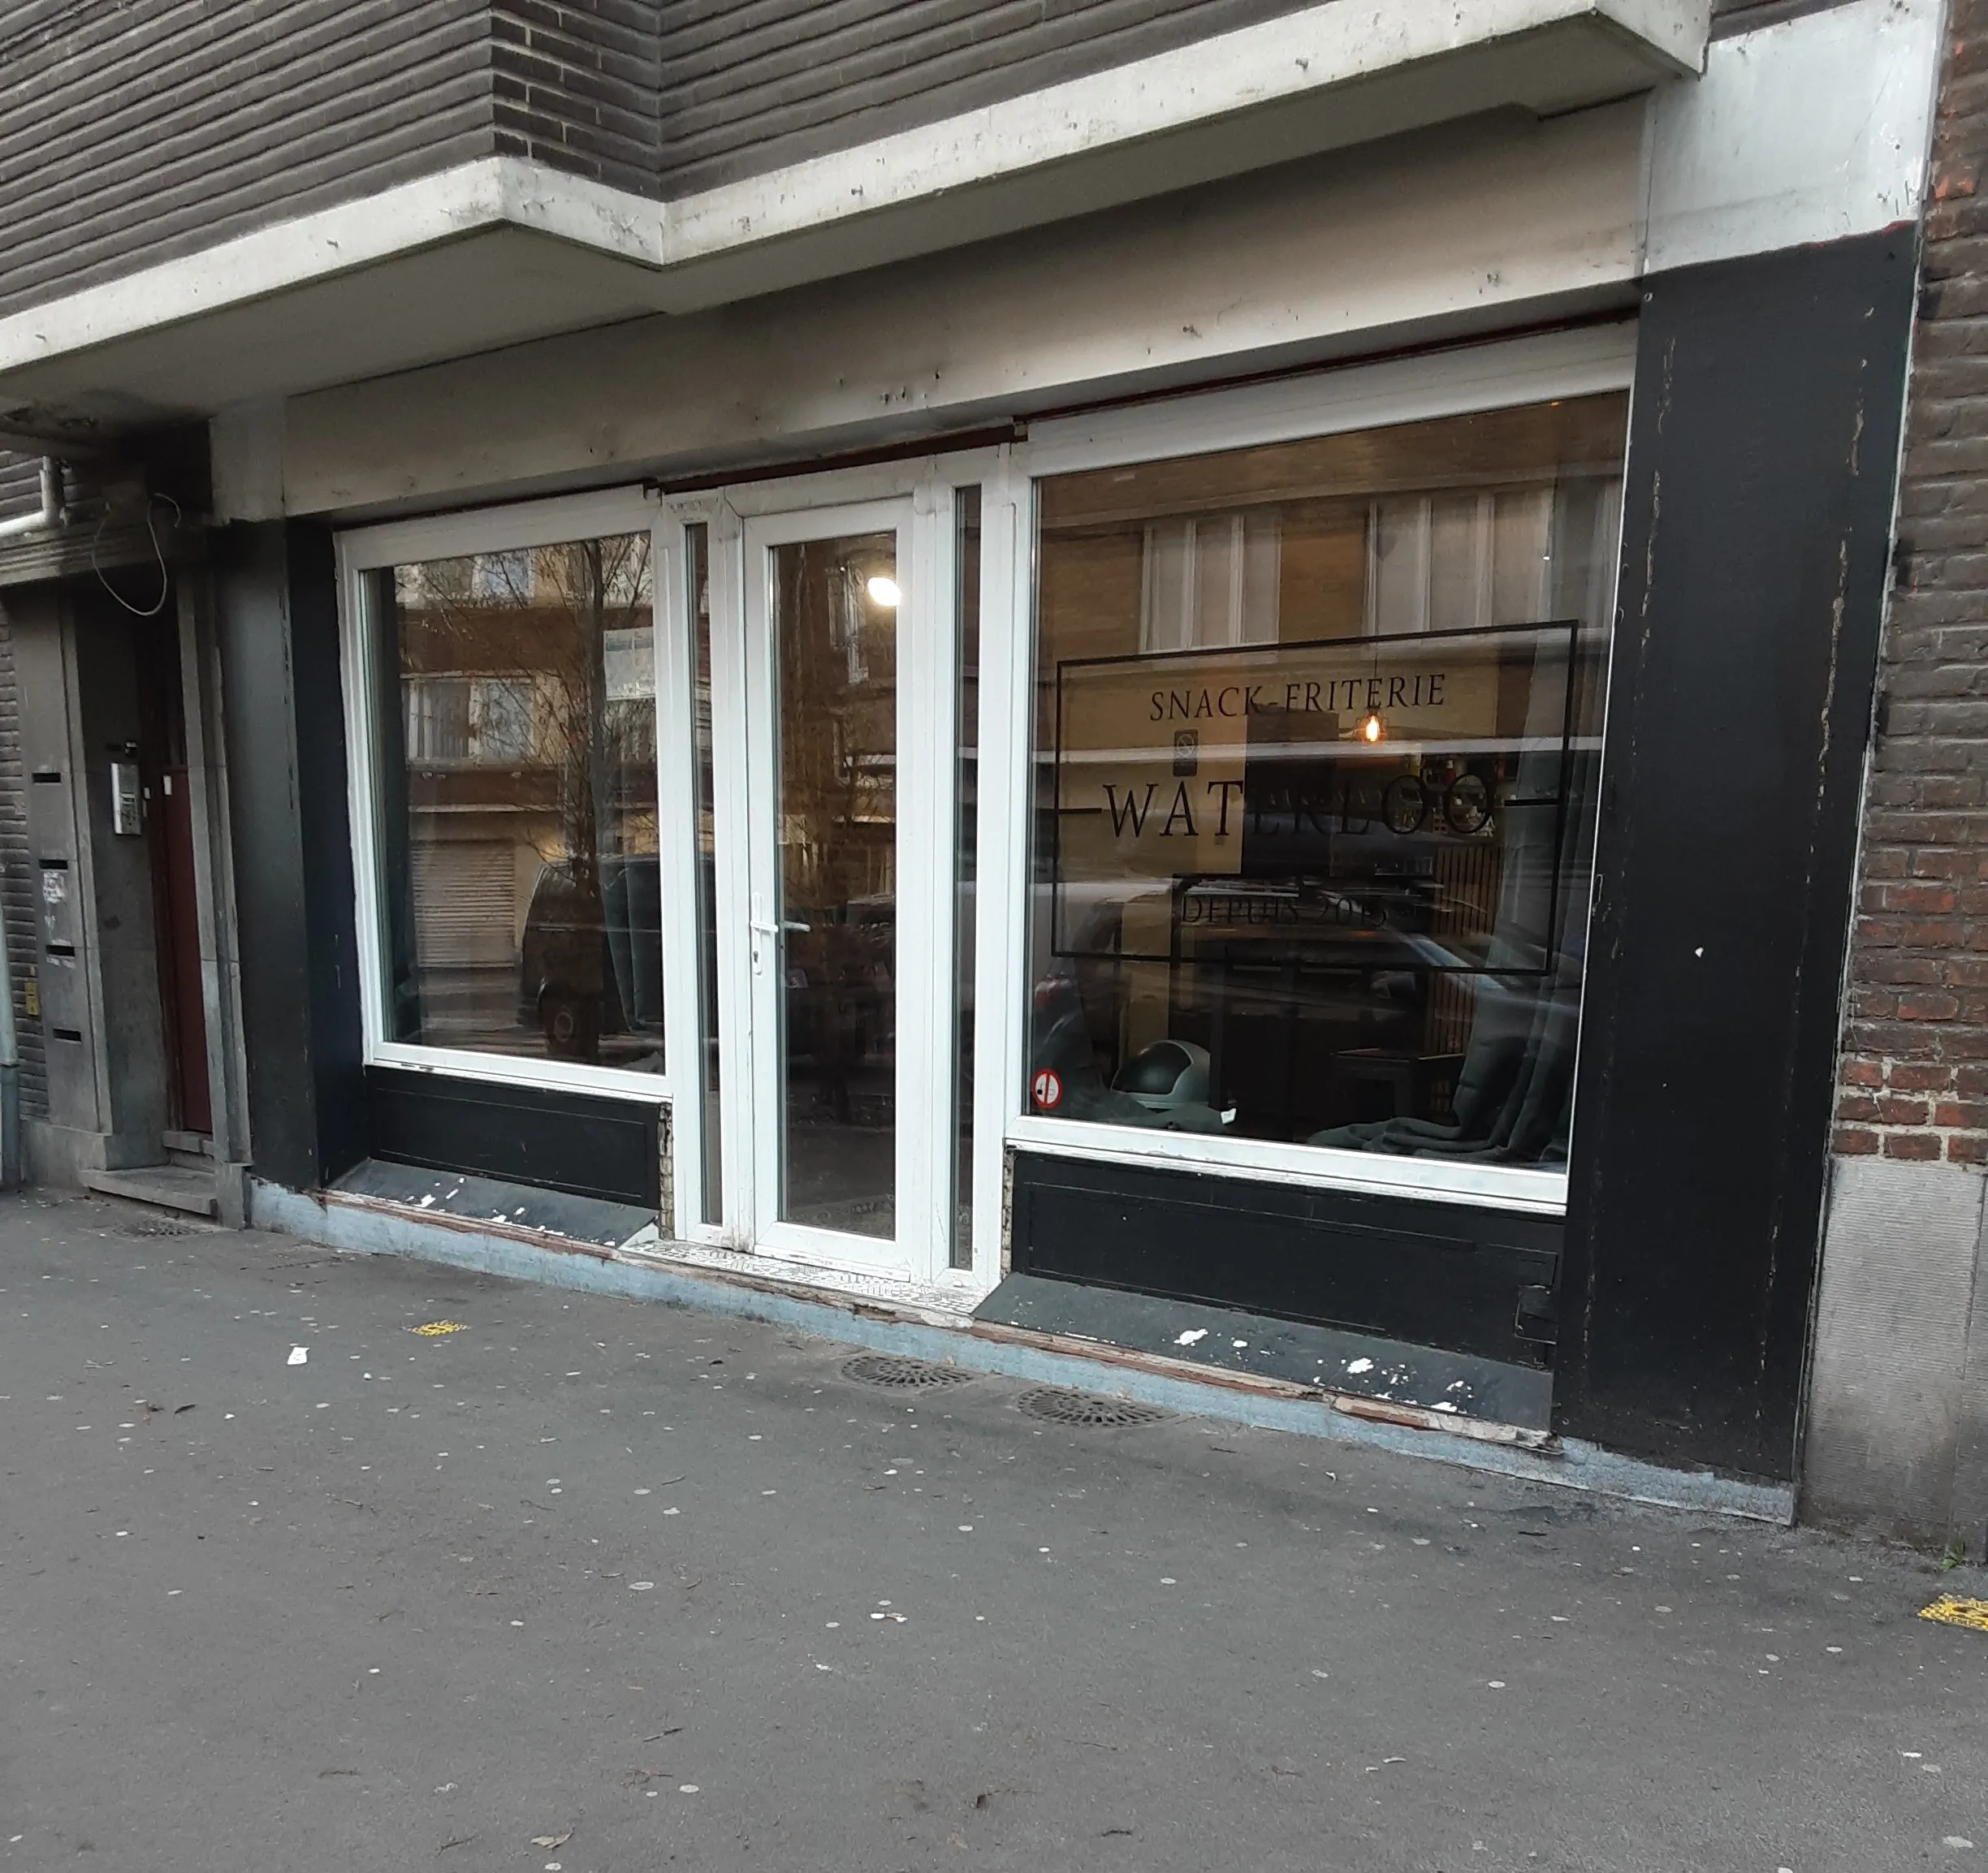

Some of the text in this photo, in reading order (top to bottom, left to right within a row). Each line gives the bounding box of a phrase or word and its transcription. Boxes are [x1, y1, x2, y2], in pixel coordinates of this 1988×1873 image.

[1150, 673, 1446, 722] SNACK-FRITERIE
[1103, 773, 1494, 839] WATERLOO
[1182, 895, 1299, 925] DEPUIS
